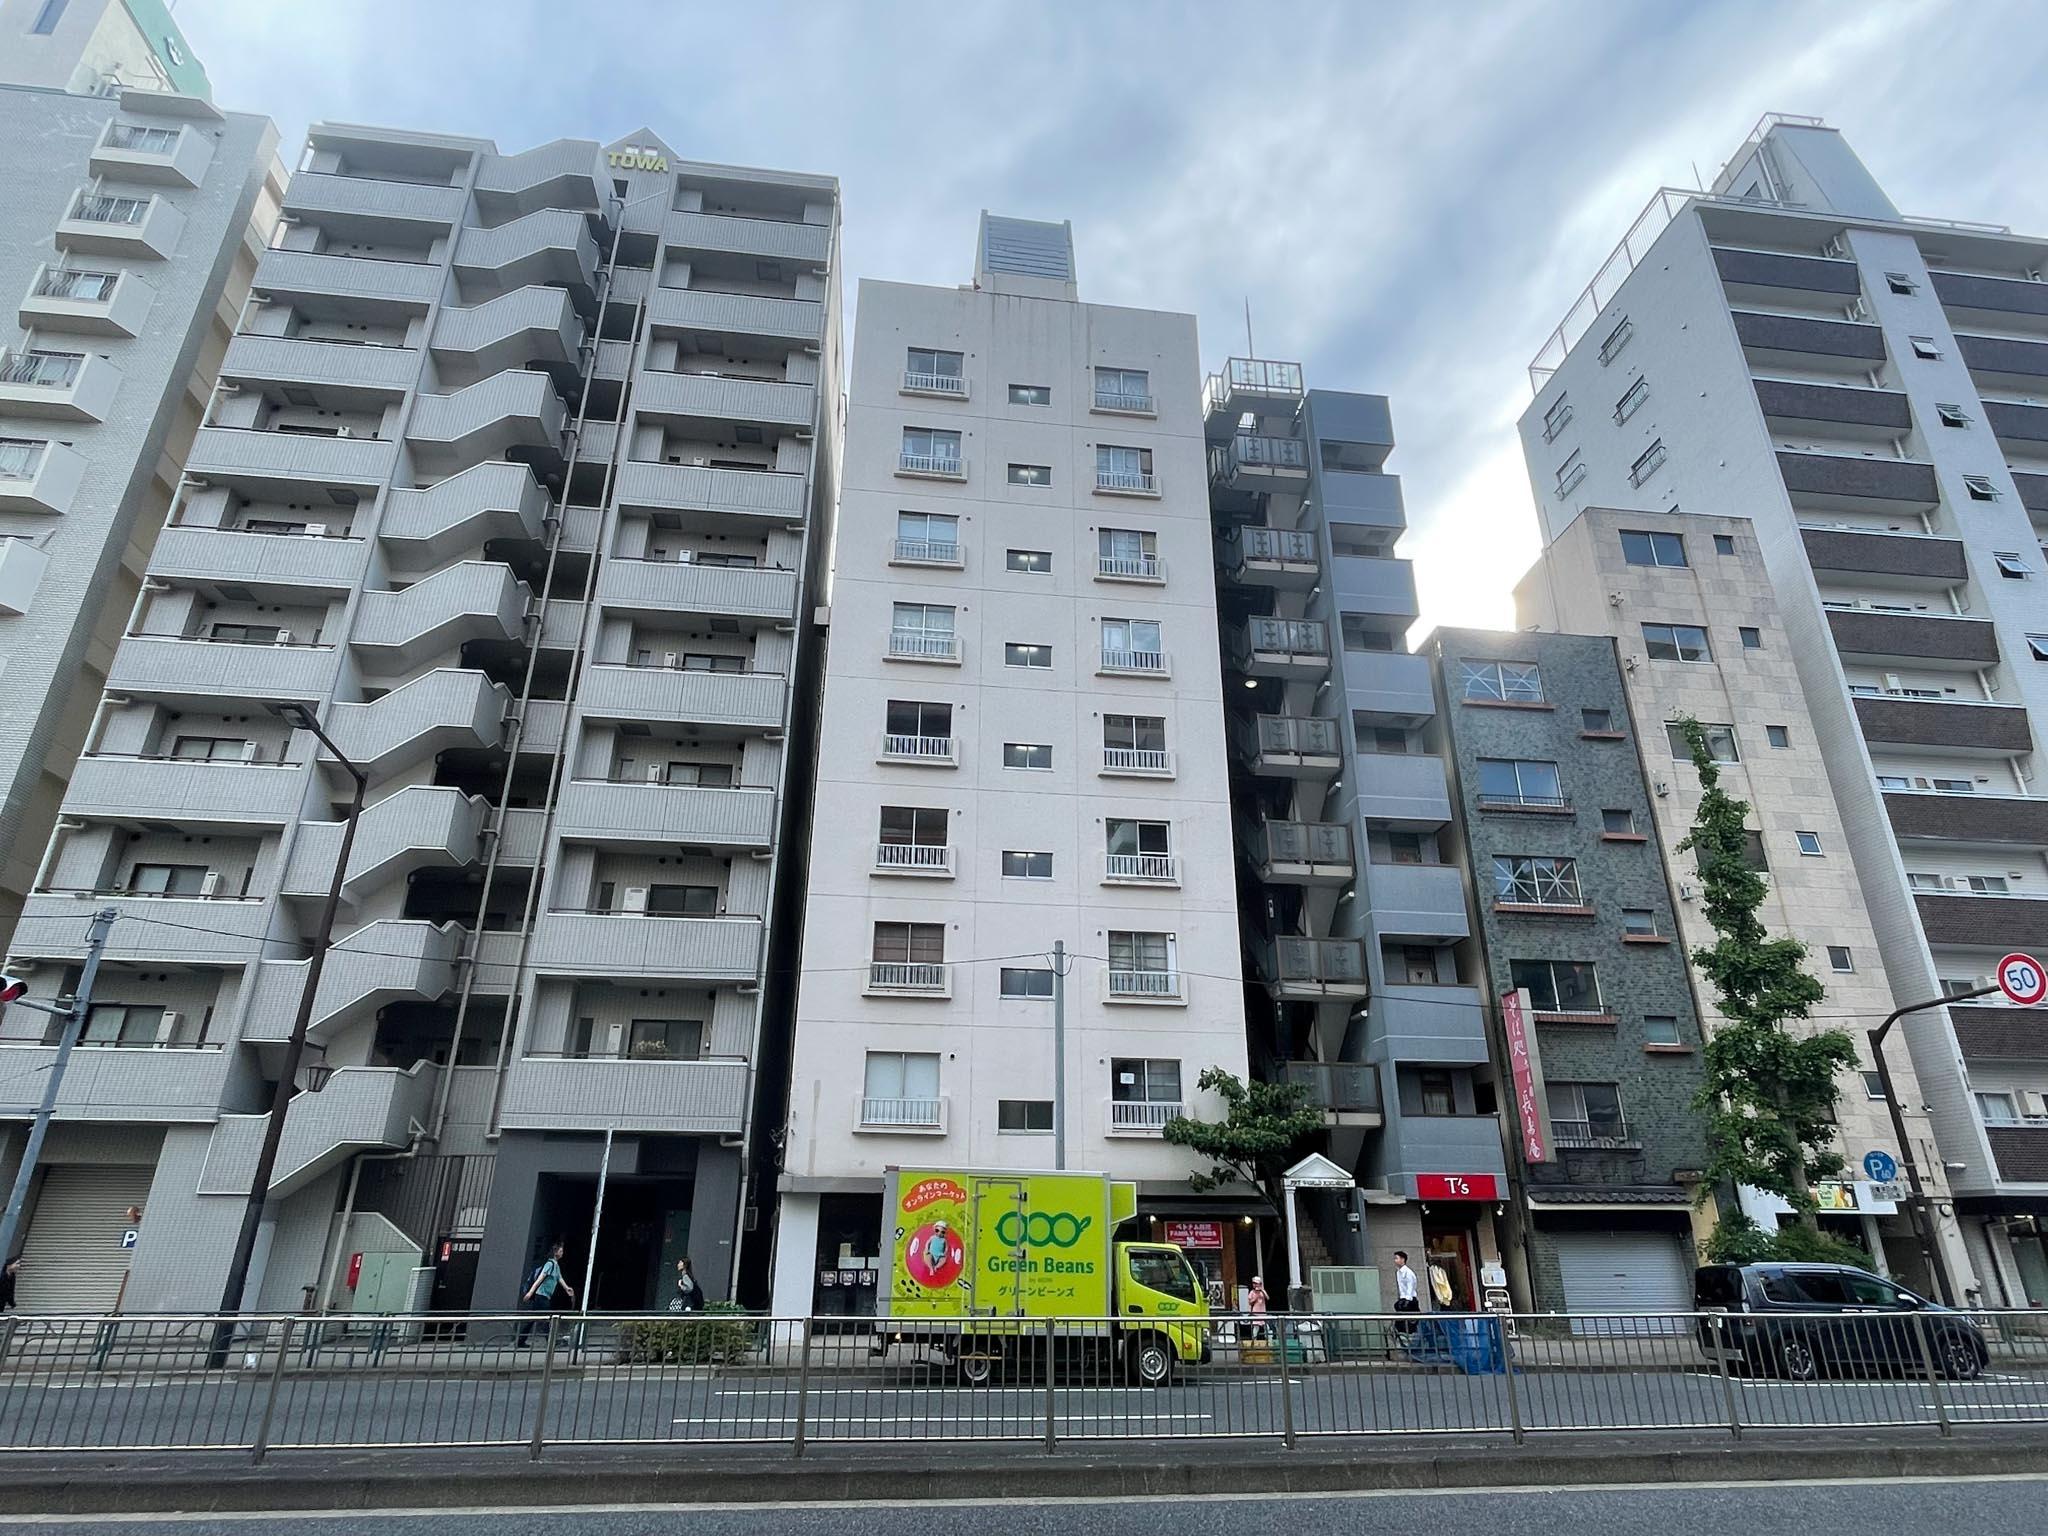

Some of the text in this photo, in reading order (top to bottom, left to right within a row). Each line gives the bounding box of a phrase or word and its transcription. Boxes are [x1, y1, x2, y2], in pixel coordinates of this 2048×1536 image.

[608, 151, 669, 173] TOWA
[2006, 967, 2036, 991] 50
[1869, 1159, 1883, 1180] P
[919, 1182, 948, 1193] あなたの
[1444, 1177, 1470, 1195] T's
[905, 1190, 966, 1209] オンラインマーケット
[122, 1230, 138, 1248] P
[987, 1255, 1094, 1274] Green Beans
[998, 1286, 1075, 1297] グリーンビーンズ
